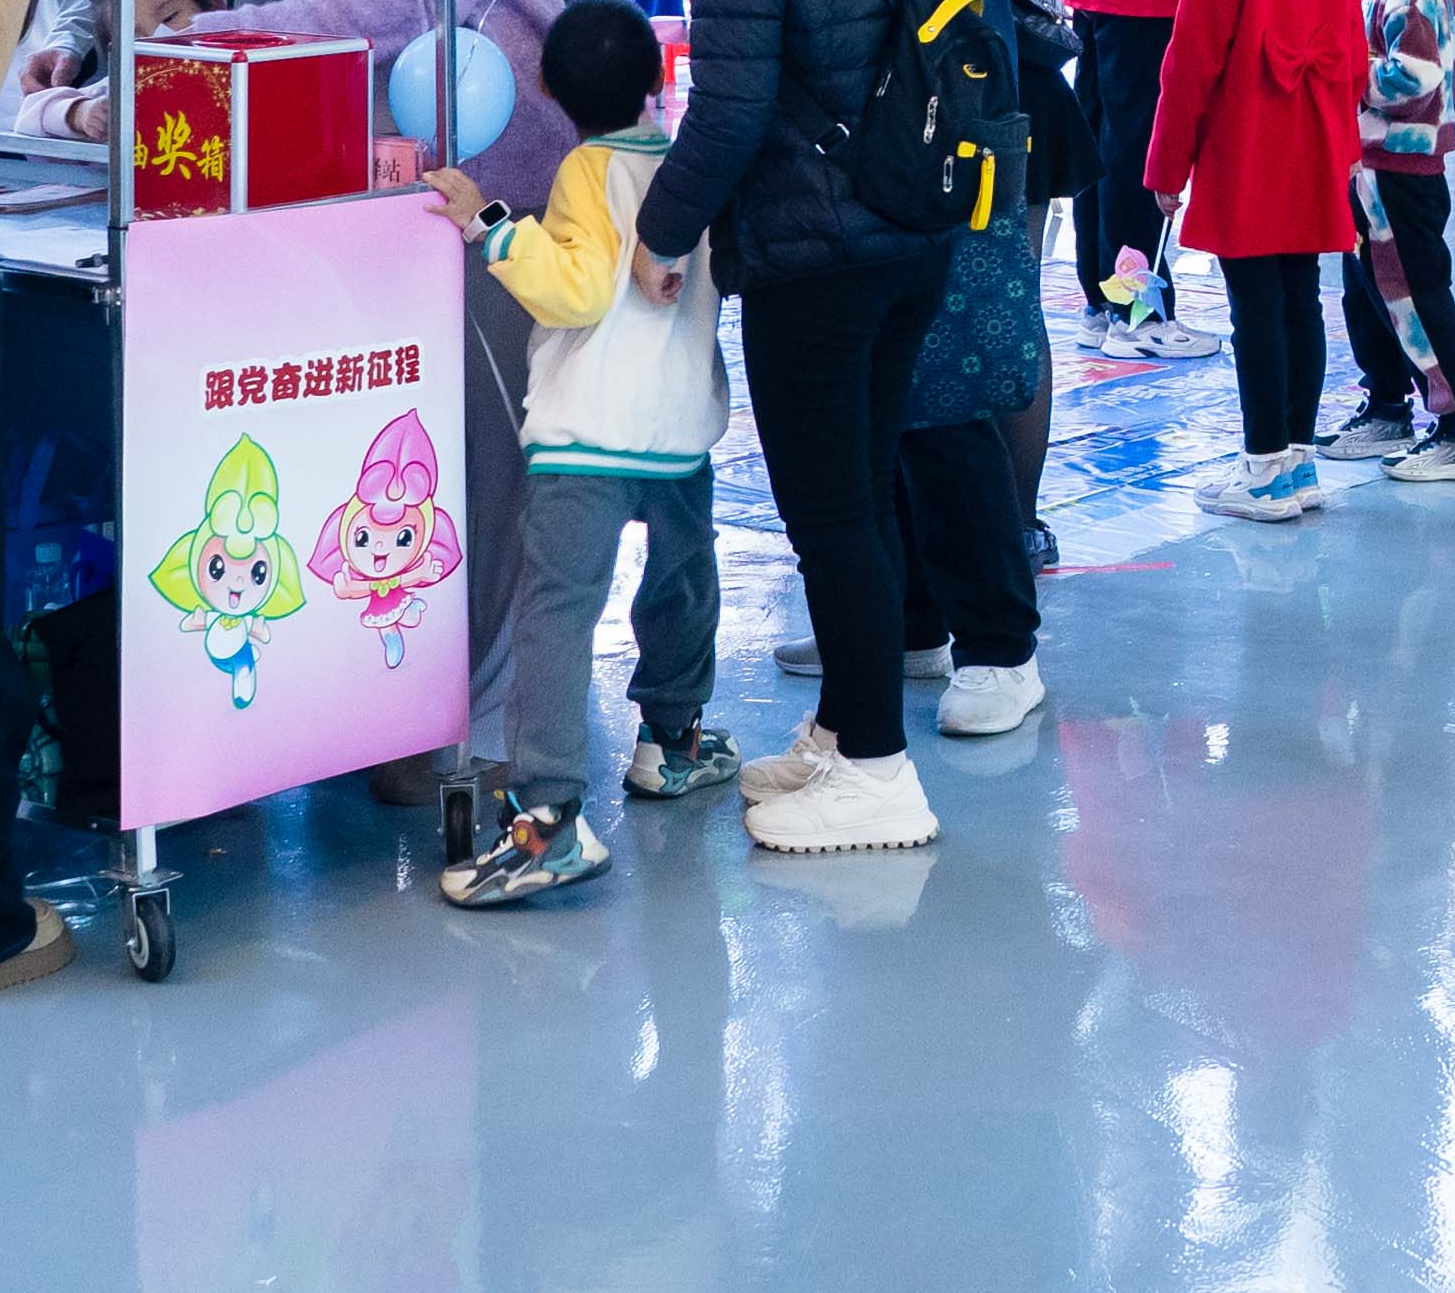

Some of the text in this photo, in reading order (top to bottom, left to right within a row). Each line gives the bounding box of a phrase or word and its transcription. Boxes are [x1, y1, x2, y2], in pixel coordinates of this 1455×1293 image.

[204, 344, 420, 411] 跟党奋进新征程
